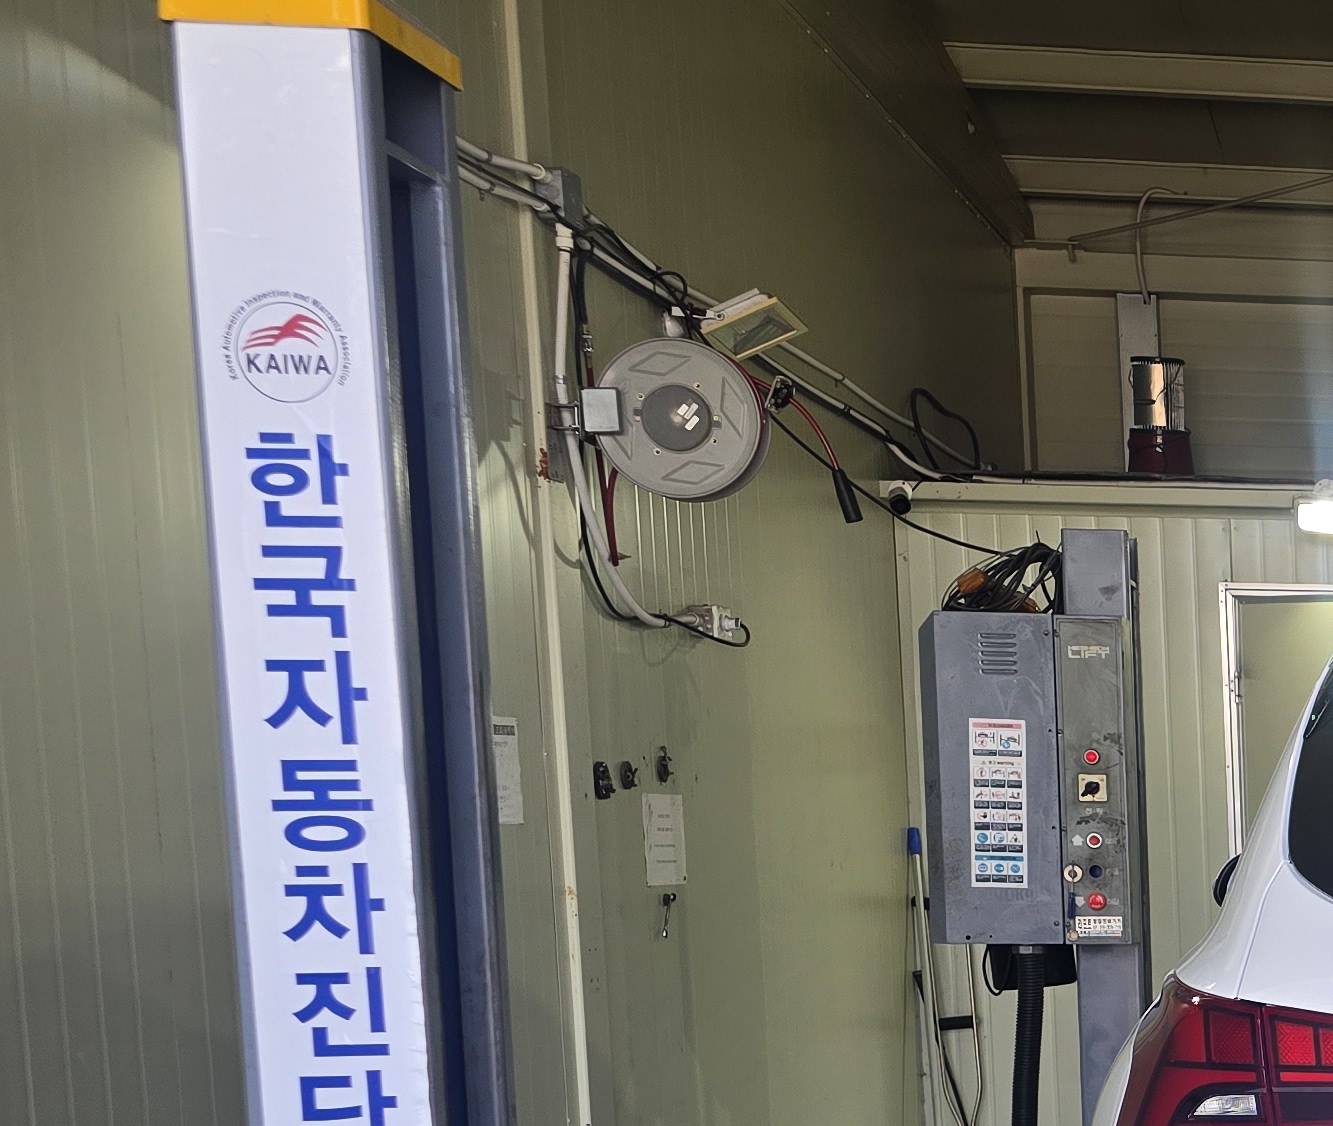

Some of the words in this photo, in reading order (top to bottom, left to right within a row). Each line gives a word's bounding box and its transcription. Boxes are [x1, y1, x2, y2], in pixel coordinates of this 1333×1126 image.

[244, 290, 292, 307] Inspection
[293, 292, 310, 303] and
[222, 306, 247, 352] Automotive
[312, 298, 344, 333] Warranty
[224, 354, 239, 381] Korea
[246, 353, 333, 375] KAIWA
[338, 335, 352, 387] Association
